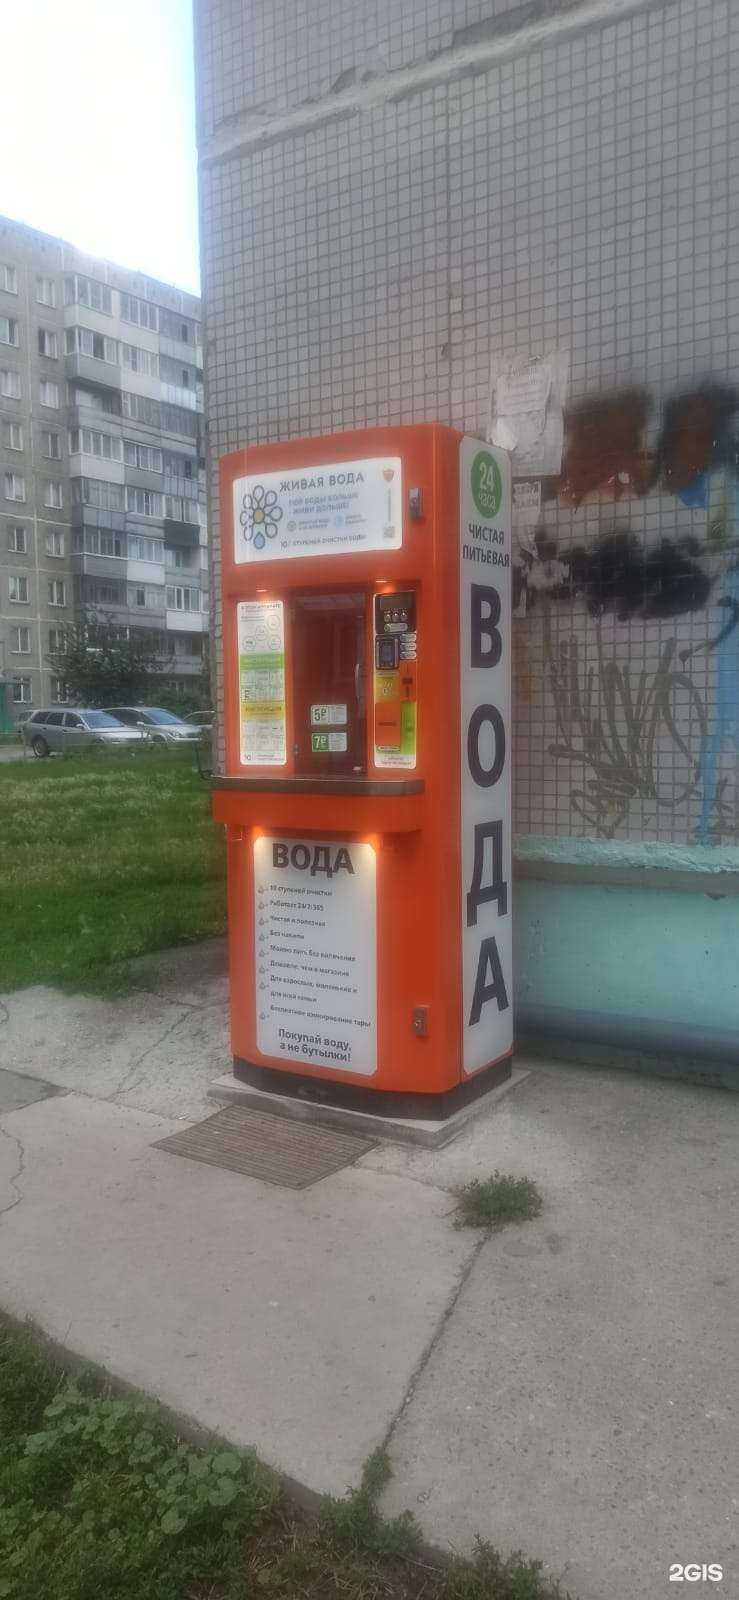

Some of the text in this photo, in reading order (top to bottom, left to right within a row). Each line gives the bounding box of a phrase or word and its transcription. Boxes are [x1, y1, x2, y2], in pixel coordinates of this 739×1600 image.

[280, 471, 365, 492] ЖИВАЯ ВОДА
[480, 462, 495, 491] 24
[468, 523, 505, 545] ЧИСТАЯ
[463, 544, 510, 567] ПИТЬЕВАЯ
[466, 583, 509, 1026] ВОДА
[272, 843, 356, 878] ВОДА
[279, 1028, 351, 1051] Покупай воду,
[287, 1044, 300, 1053] не
[302, 1045, 351, 1062] бутылки!
